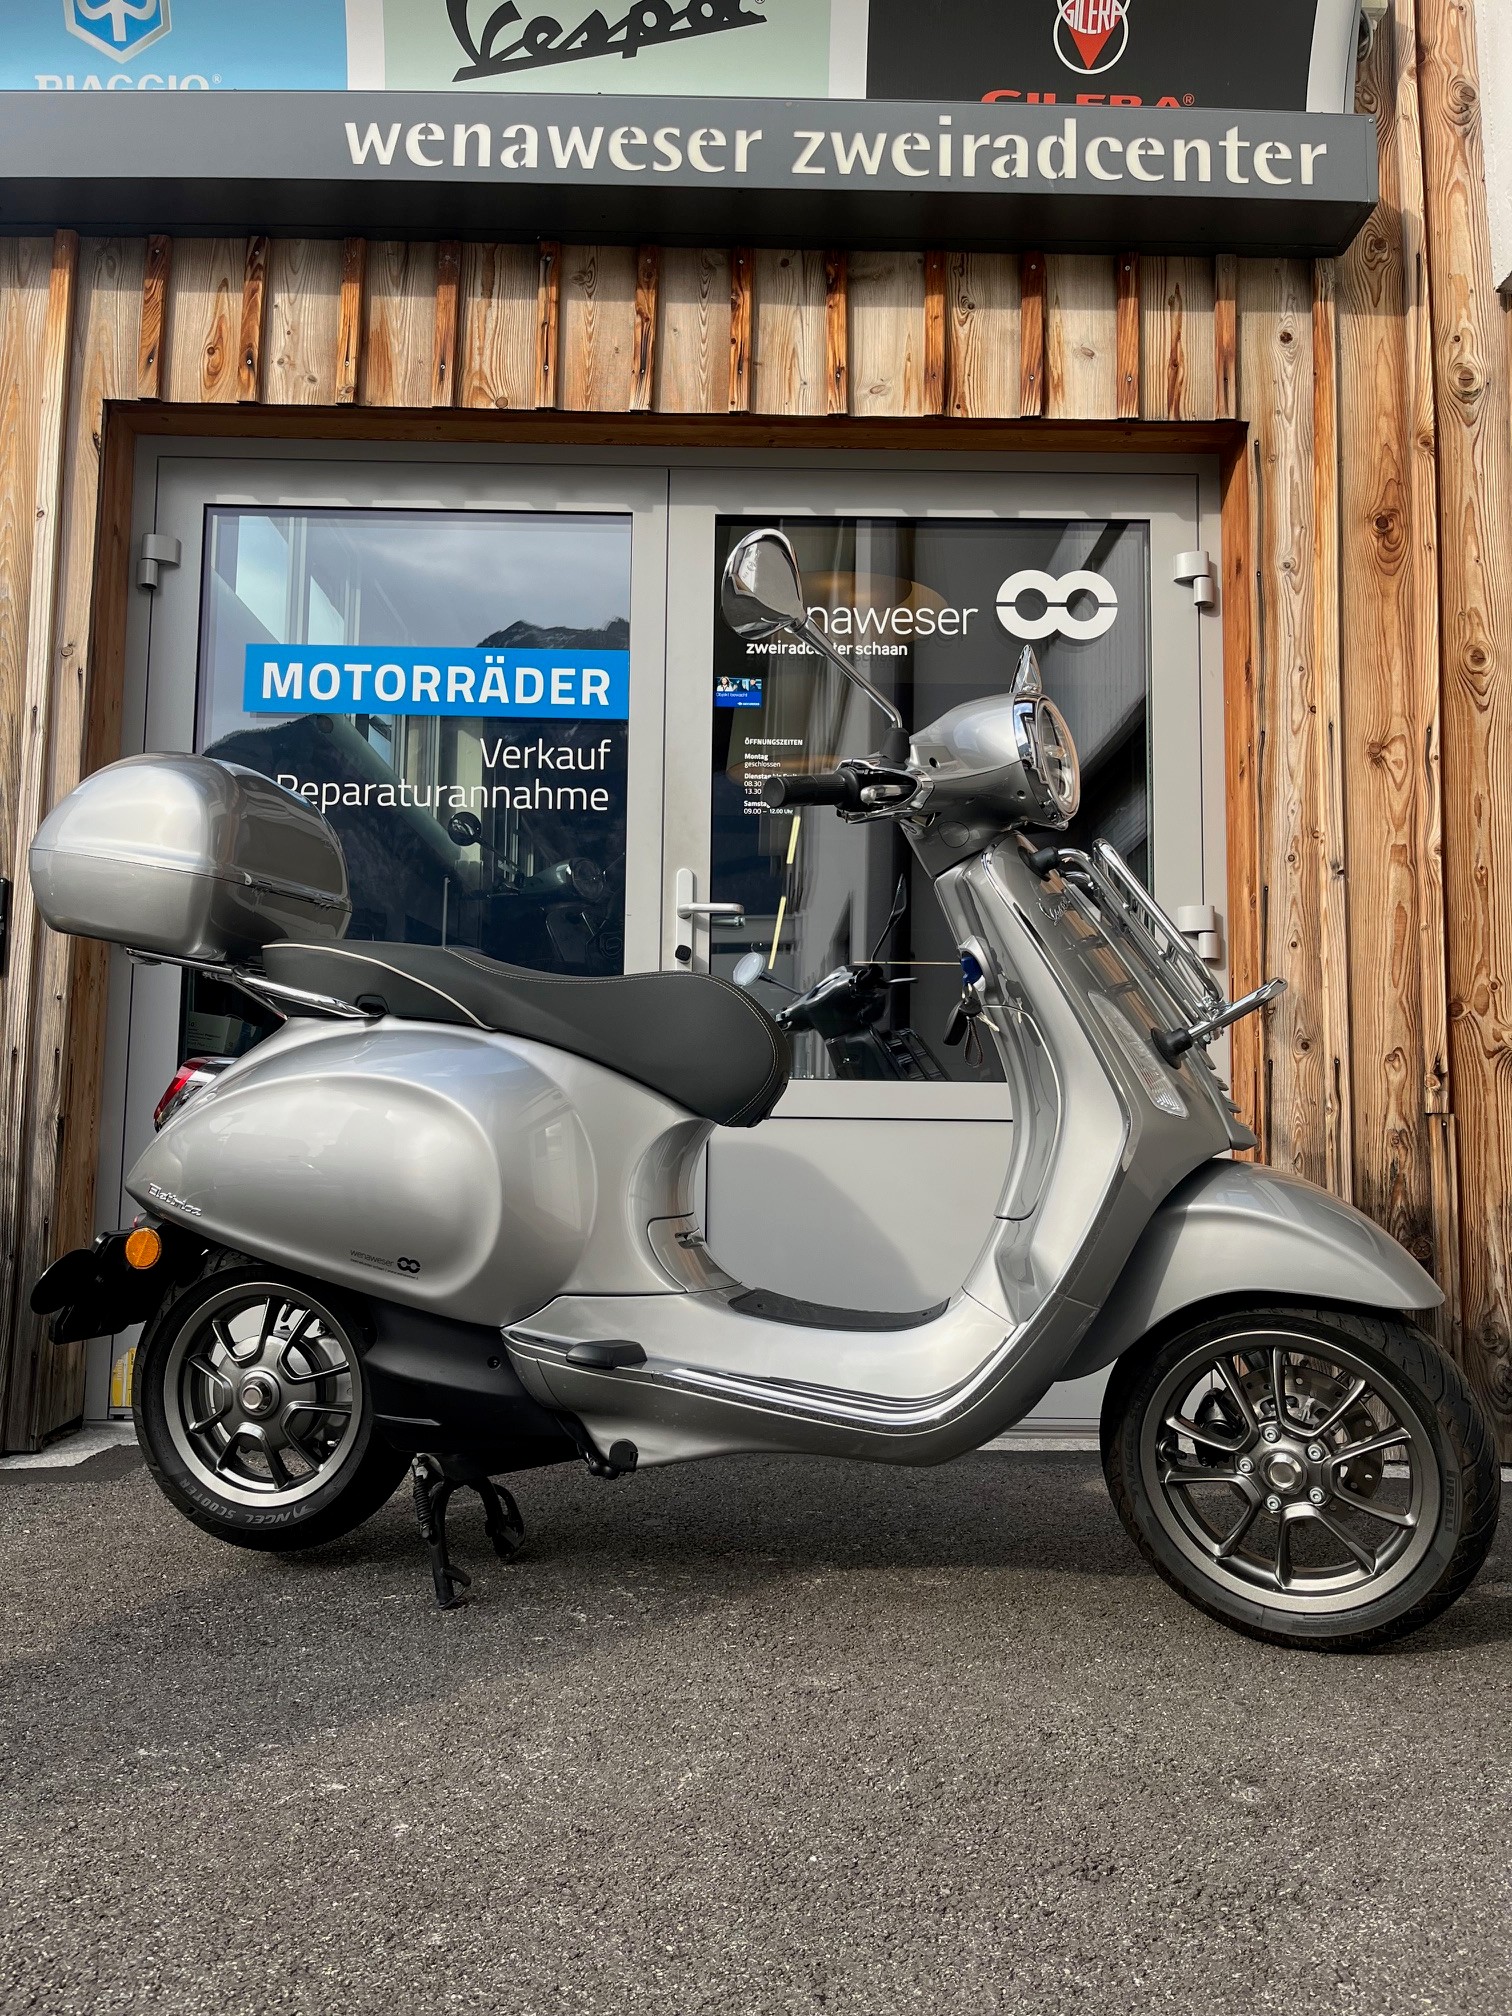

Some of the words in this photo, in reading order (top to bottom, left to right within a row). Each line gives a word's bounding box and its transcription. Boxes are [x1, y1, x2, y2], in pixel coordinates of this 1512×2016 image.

[1063, 0, 1124, 35] GILERA
[445, 0, 767, 82] Vespa
[345, 121, 763, 173] wenaweser
[792, 115, 1328, 186] zweiradcenter
[784, 605, 979, 636] naweser
[745, 640, 854, 656] zweiradcter
[855, 640, 908, 656] schaan
[261, 655, 611, 706] MOTORRÄDER
[480, 738, 612, 770] Verkauf
[744, 737, 803, 746] ÖFFNUNGSZEITEN
[744, 753, 769, 761] Montag
[744, 761, 781, 769] geschlossen
[350, 1249, 395, 1267] wenaweser
[179, 1478, 237, 1519] SCOOTER
